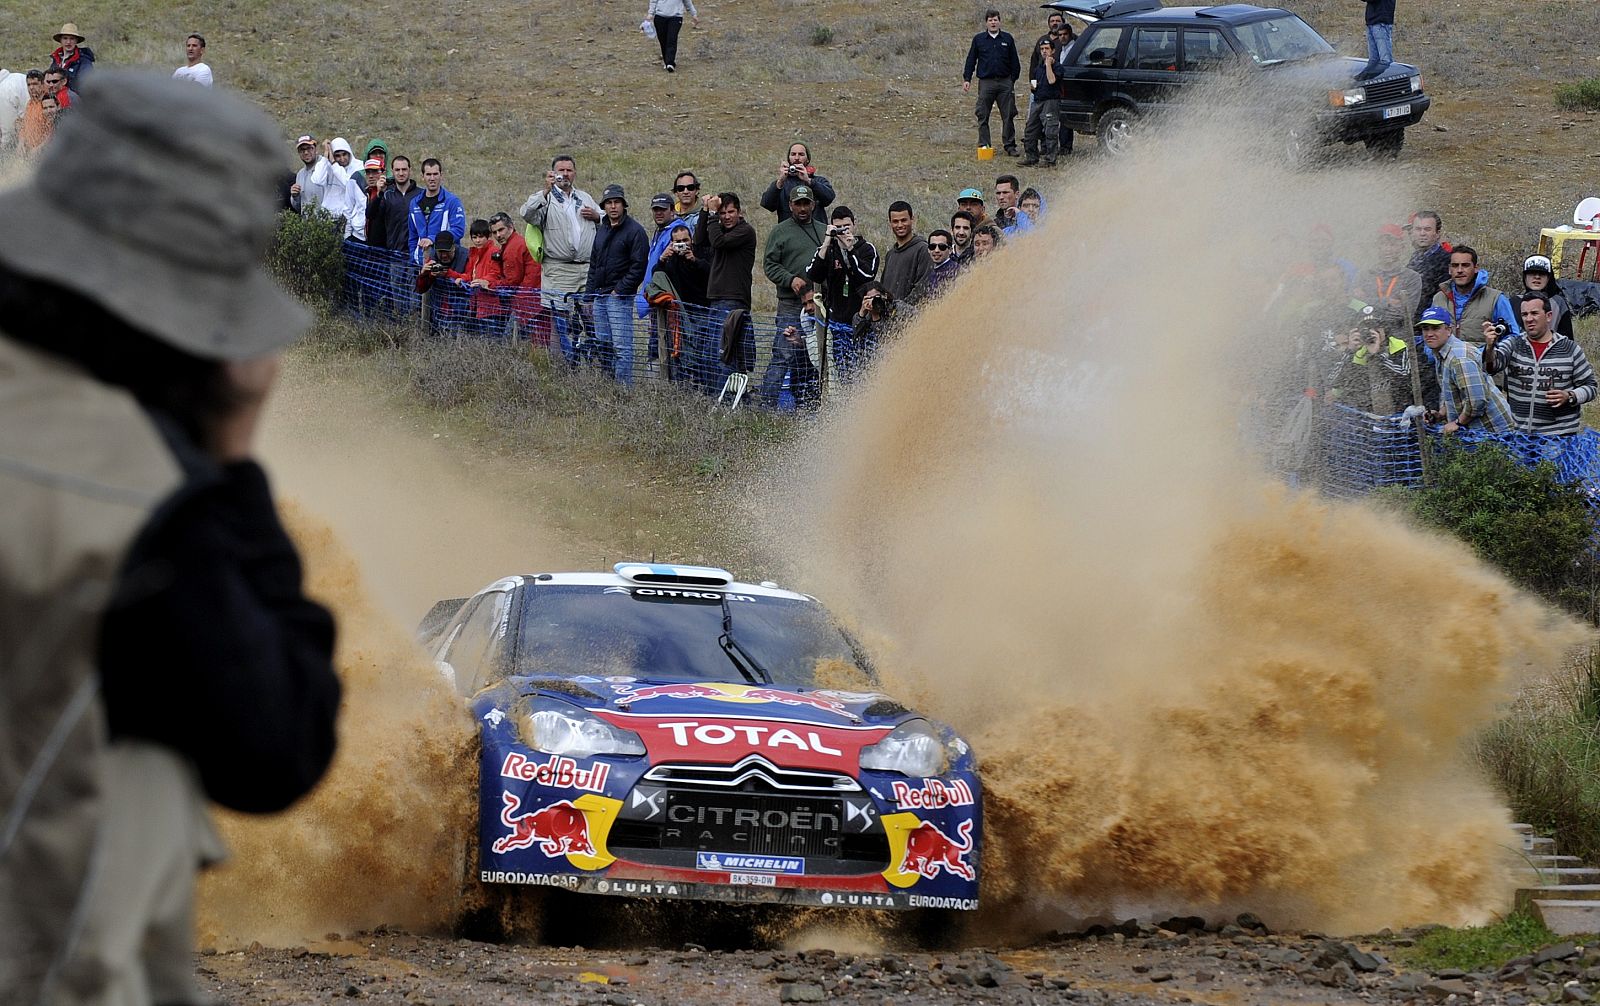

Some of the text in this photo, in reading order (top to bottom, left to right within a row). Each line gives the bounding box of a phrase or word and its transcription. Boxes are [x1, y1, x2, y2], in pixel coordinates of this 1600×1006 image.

[657, 722, 842, 756] TOTAL
[723, 857, 800, 870] MICHELIN
[481, 870, 579, 888] EURODATACAR
[732, 874, 774, 885] BK-359-DW
[613, 882, 679, 895] LUHTA
[836, 895, 895, 906] LUHTA
